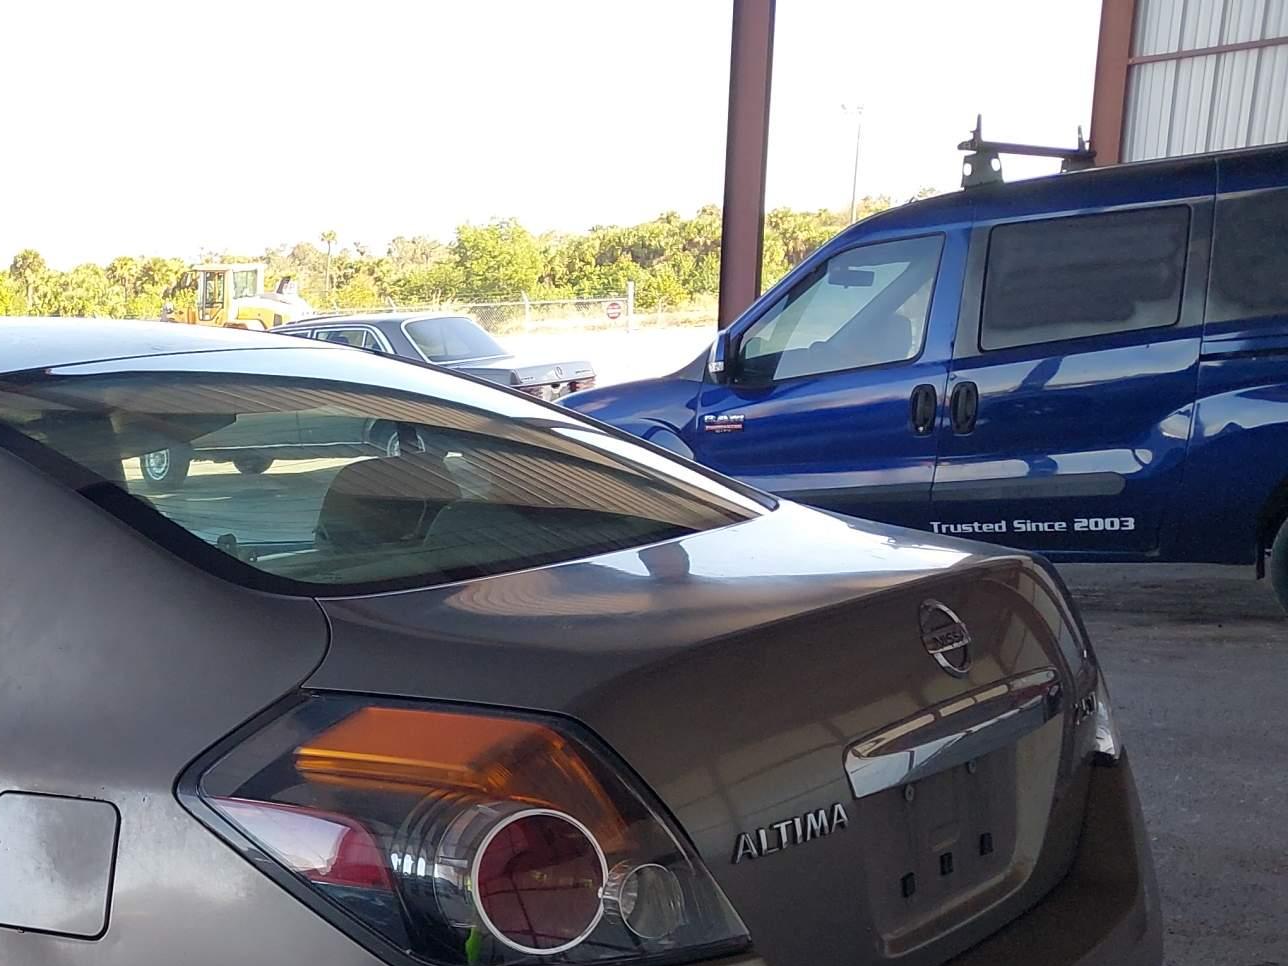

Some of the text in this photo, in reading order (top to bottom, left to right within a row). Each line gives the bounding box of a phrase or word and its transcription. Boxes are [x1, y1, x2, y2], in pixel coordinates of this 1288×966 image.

[930, 517, 1135, 534] Trusted Since 2003
[732, 803, 849, 864] ALTIMA
